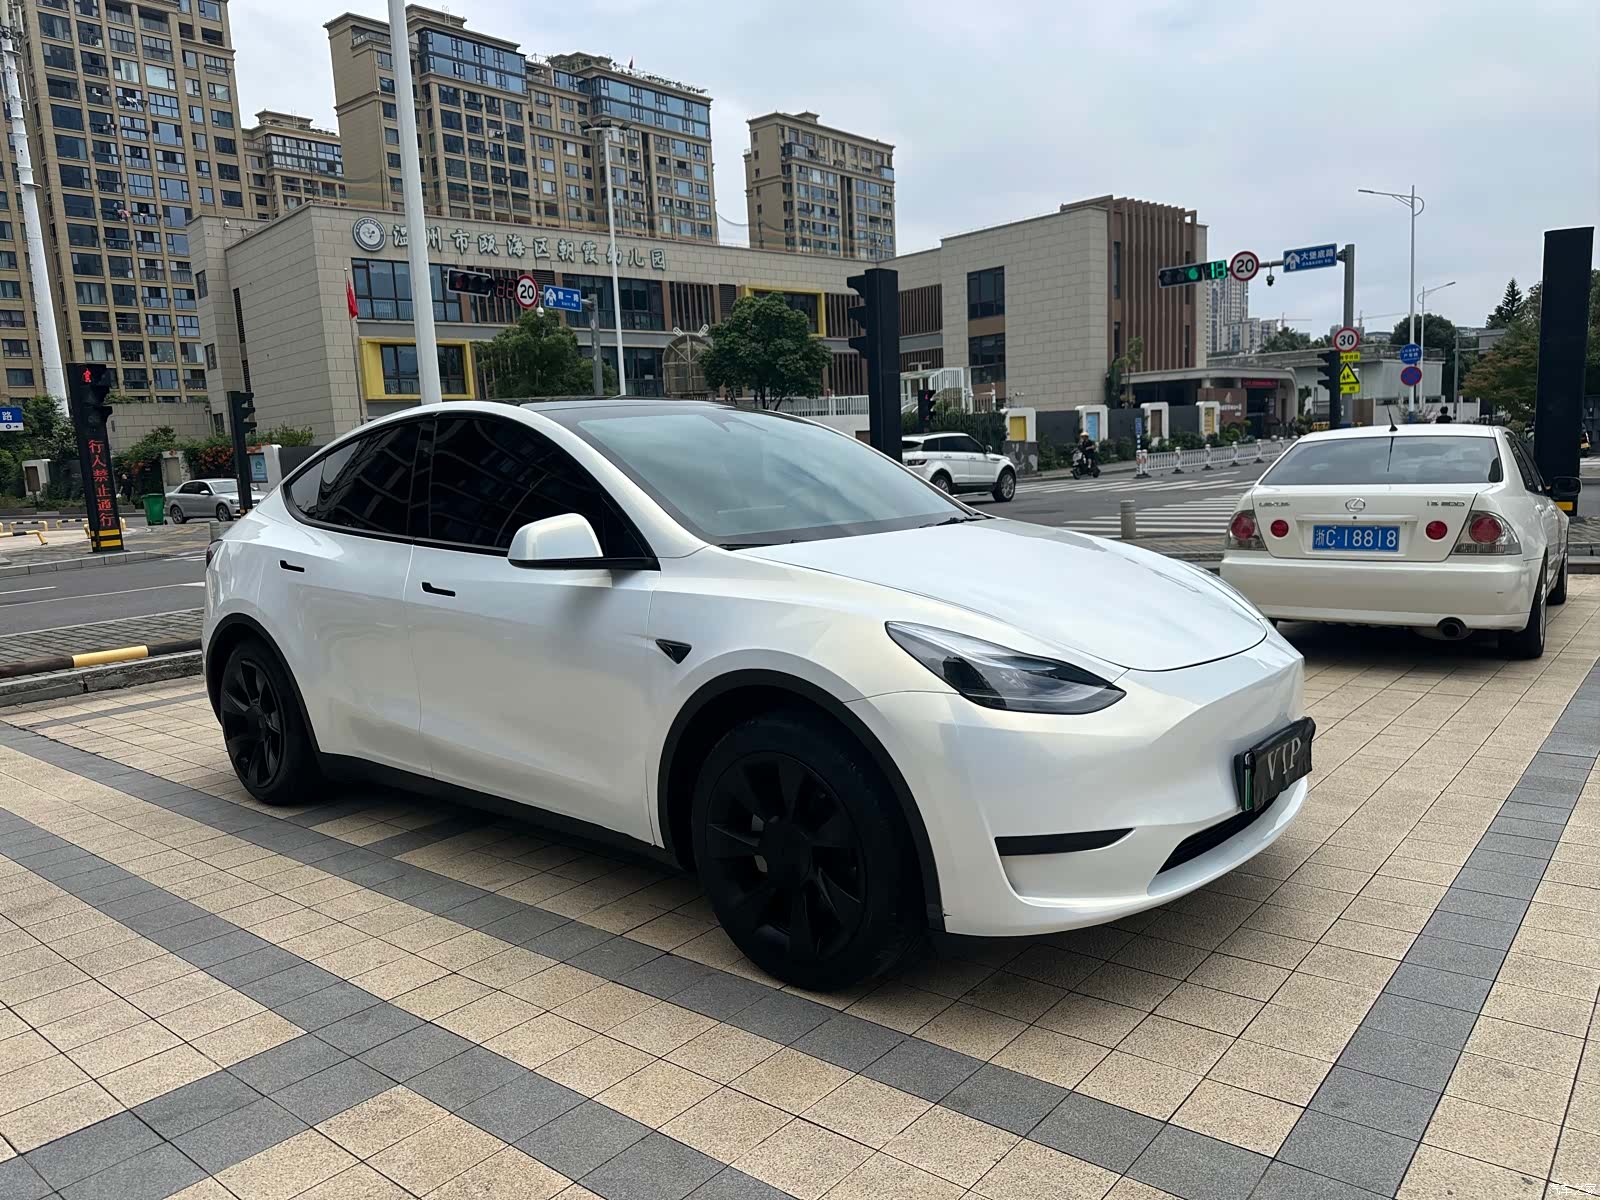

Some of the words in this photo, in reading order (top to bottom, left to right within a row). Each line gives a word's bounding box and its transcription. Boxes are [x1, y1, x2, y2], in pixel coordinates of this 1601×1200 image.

[1210, 261, 1226, 279] 18
[1236, 259, 1254, 273] 20
[520, 284, 534, 299] 20
[1339, 334, 1354, 346] 30
[89, 439, 114, 527] 行人禁止通行
[1267, 737, 1301, 781] VIP
